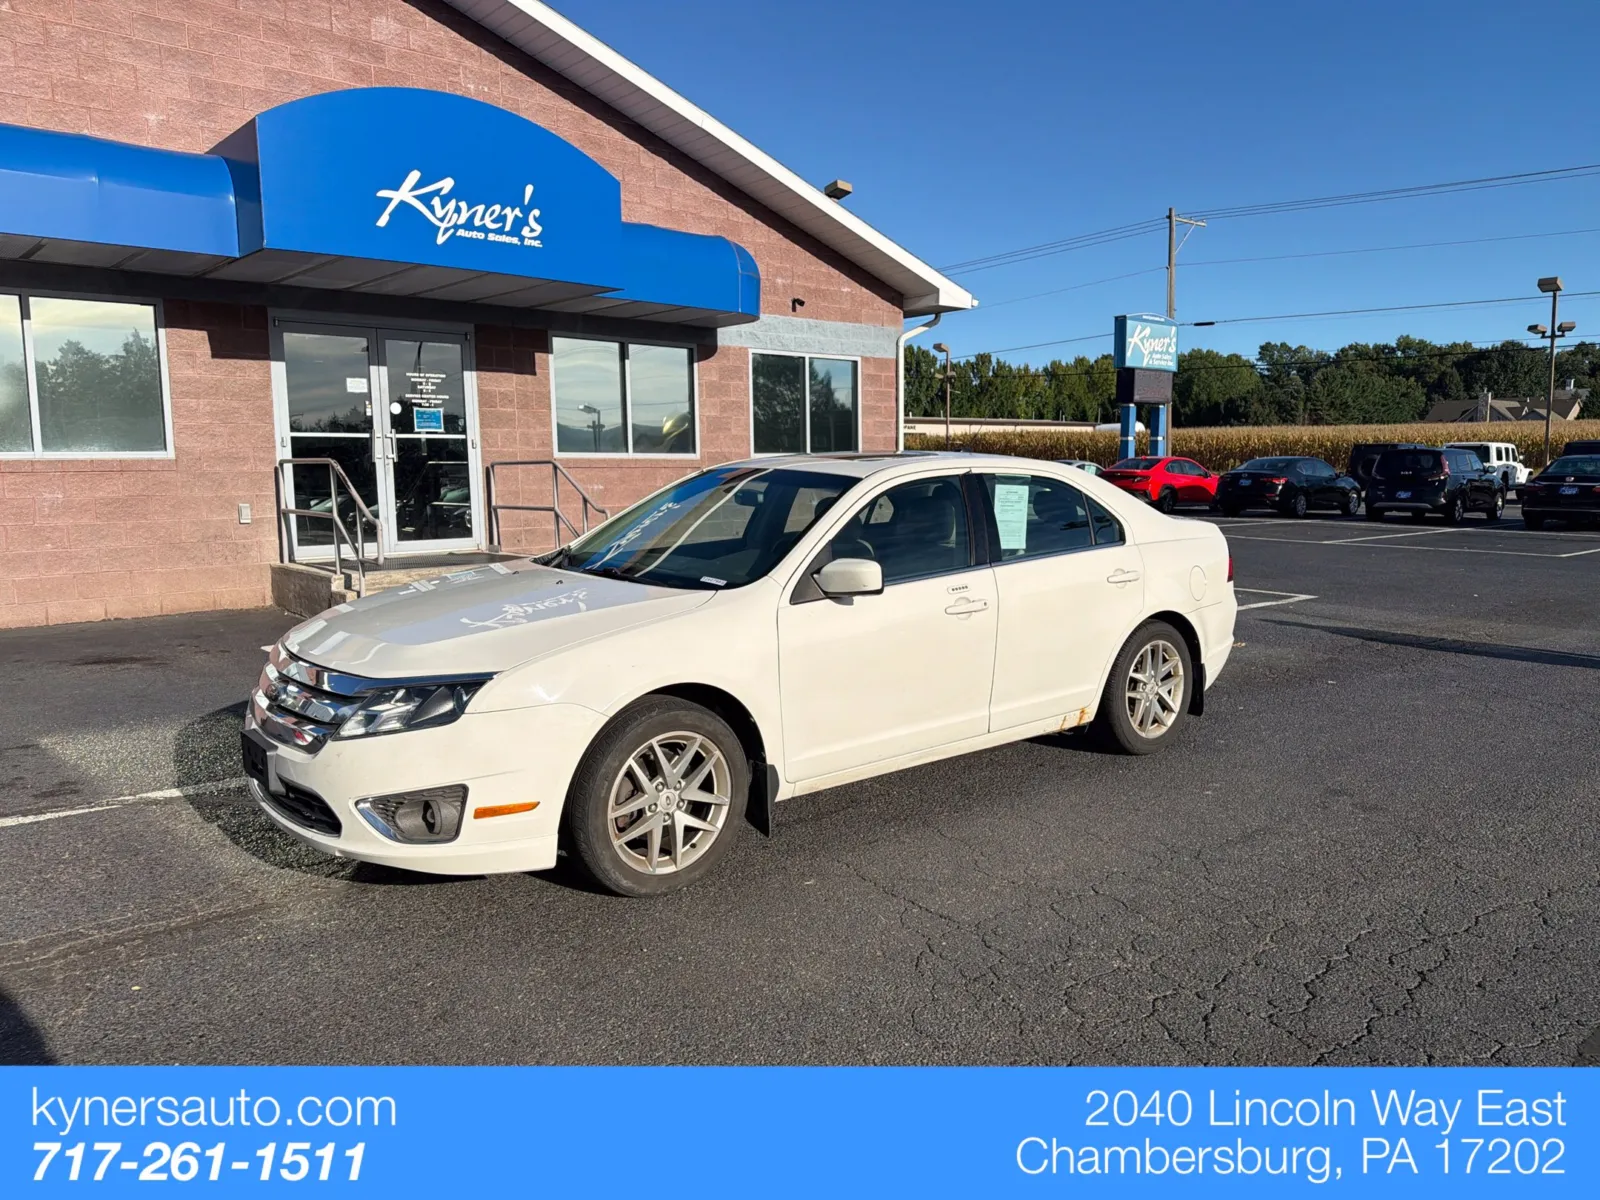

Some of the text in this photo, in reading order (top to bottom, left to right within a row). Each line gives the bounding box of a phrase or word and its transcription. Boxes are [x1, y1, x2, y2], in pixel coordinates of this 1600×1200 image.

[376, 169, 543, 245] Kyner's
[456, 228, 543, 248] Auto Sales, Inc.
[1127, 324, 1177, 368] Kyner's
